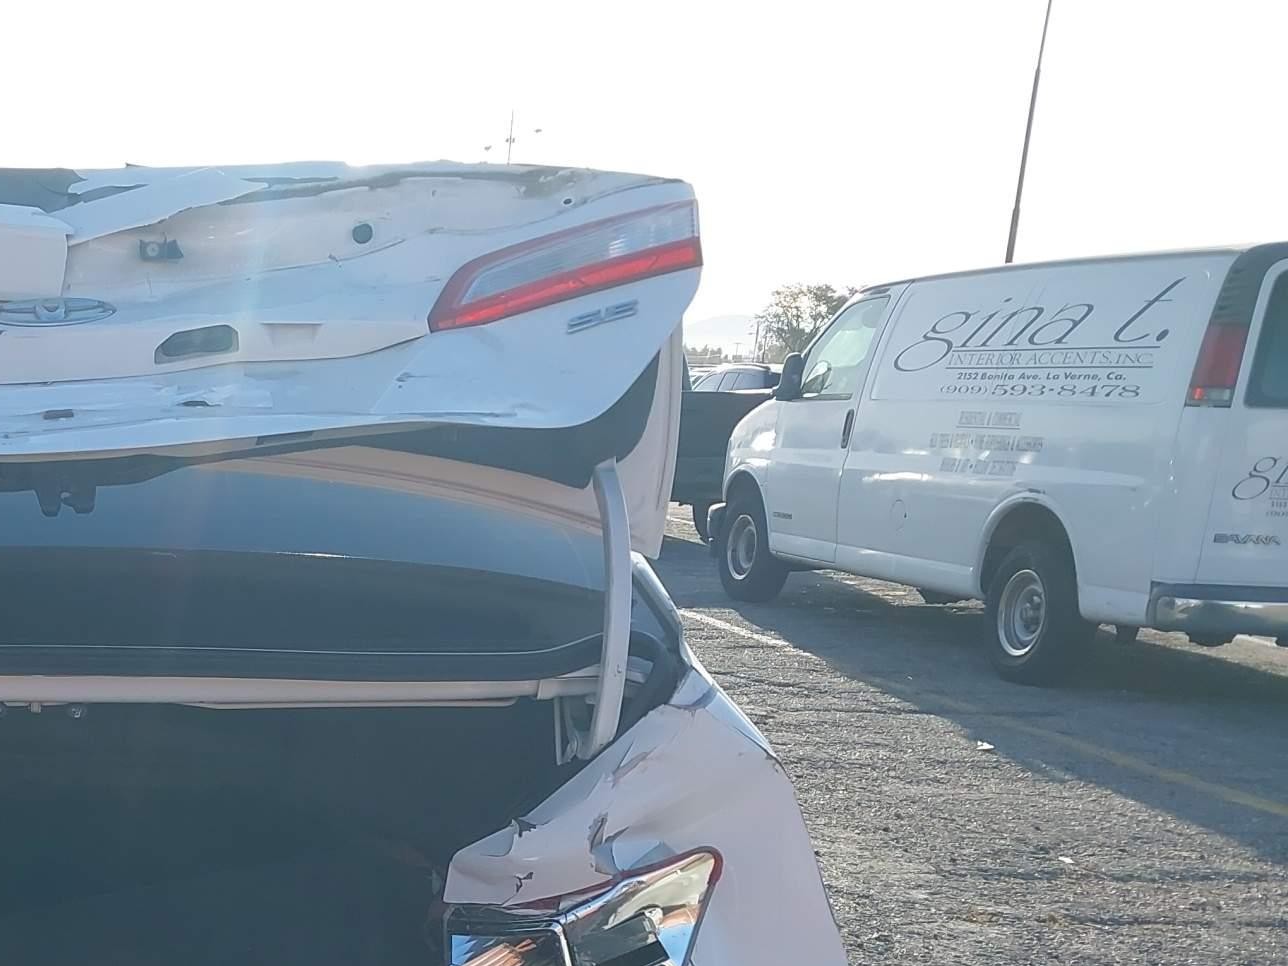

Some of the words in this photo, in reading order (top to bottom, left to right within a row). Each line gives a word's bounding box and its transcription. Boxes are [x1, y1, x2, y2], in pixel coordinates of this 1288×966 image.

[894, 297, 1094, 372] gina
[948, 351, 1021, 366] INTERIOR
[957, 371, 979, 380] 2152
[980, 372, 1015, 381] Bonita
[1018, 371, 1042, 380] Ave.
[1046, 372, 1060, 380] La
[1064, 371, 1101, 382] Verne,
[1106, 371, 1127, 380] Ca.
[940, 384, 988, 395] (909)
